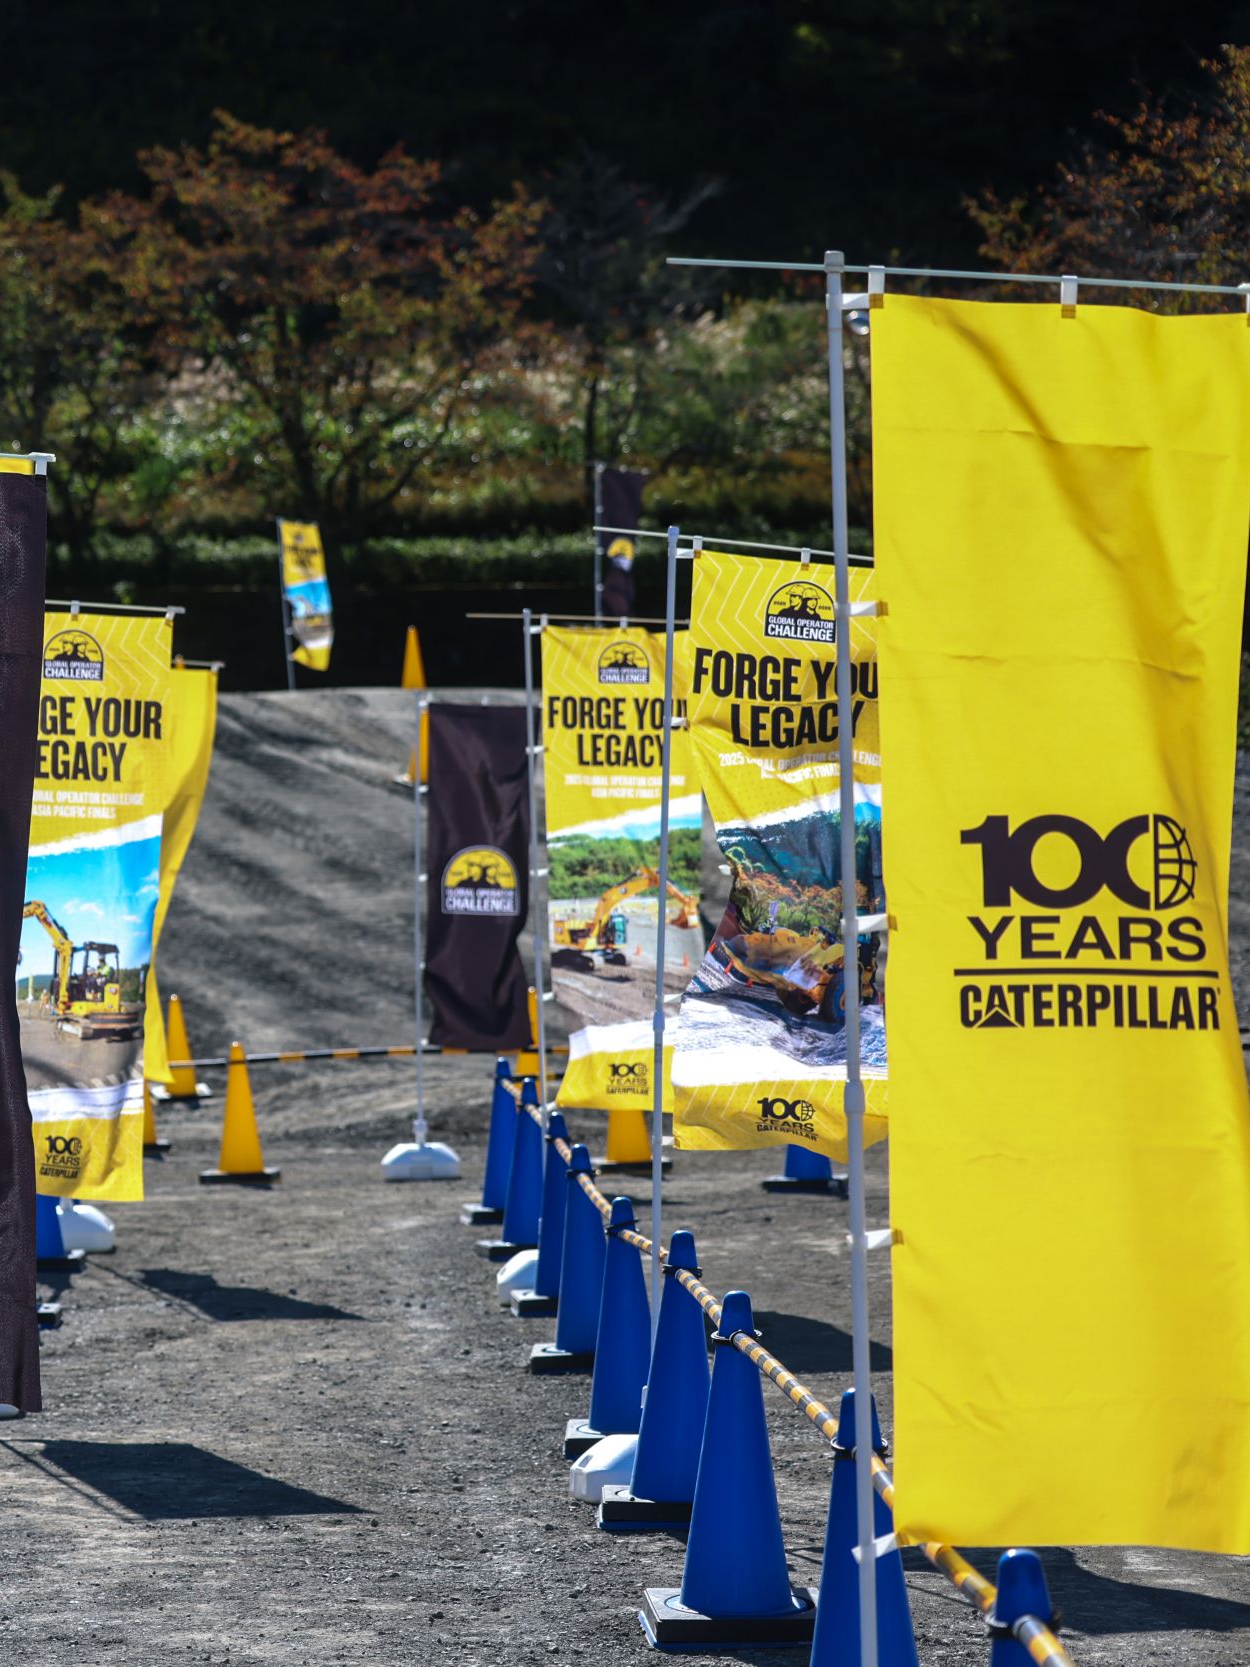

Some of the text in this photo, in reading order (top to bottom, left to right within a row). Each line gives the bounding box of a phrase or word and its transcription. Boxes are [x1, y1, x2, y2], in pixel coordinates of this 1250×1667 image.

[768, 616, 834, 630] GLOBAL OPERATOR
[768, 624, 833, 642] CHALLENGE
[44, 668, 101, 680] CHALLENGE
[693, 647, 801, 702] FORGE
[84, 697, 162, 739] YOUR
[548, 696, 626, 730] FORGE
[731, 701, 865, 748] LEGACY
[35, 740, 127, 782] EGACY
[718, 751, 745, 766] 2025
[960, 813, 1198, 911] 100
[446, 896, 514, 913] CHALLENGE
[967, 915, 1206, 962] YEARS
[960, 983, 1220, 1031] CATERPILLAR
[608, 1063, 648, 1077] 100
[757, 1097, 815, 1121] 100
[758, 1117, 814, 1133] YEARS
[45, 1135, 83, 1156] 100
[46, 1154, 80, 1166] YEARS
